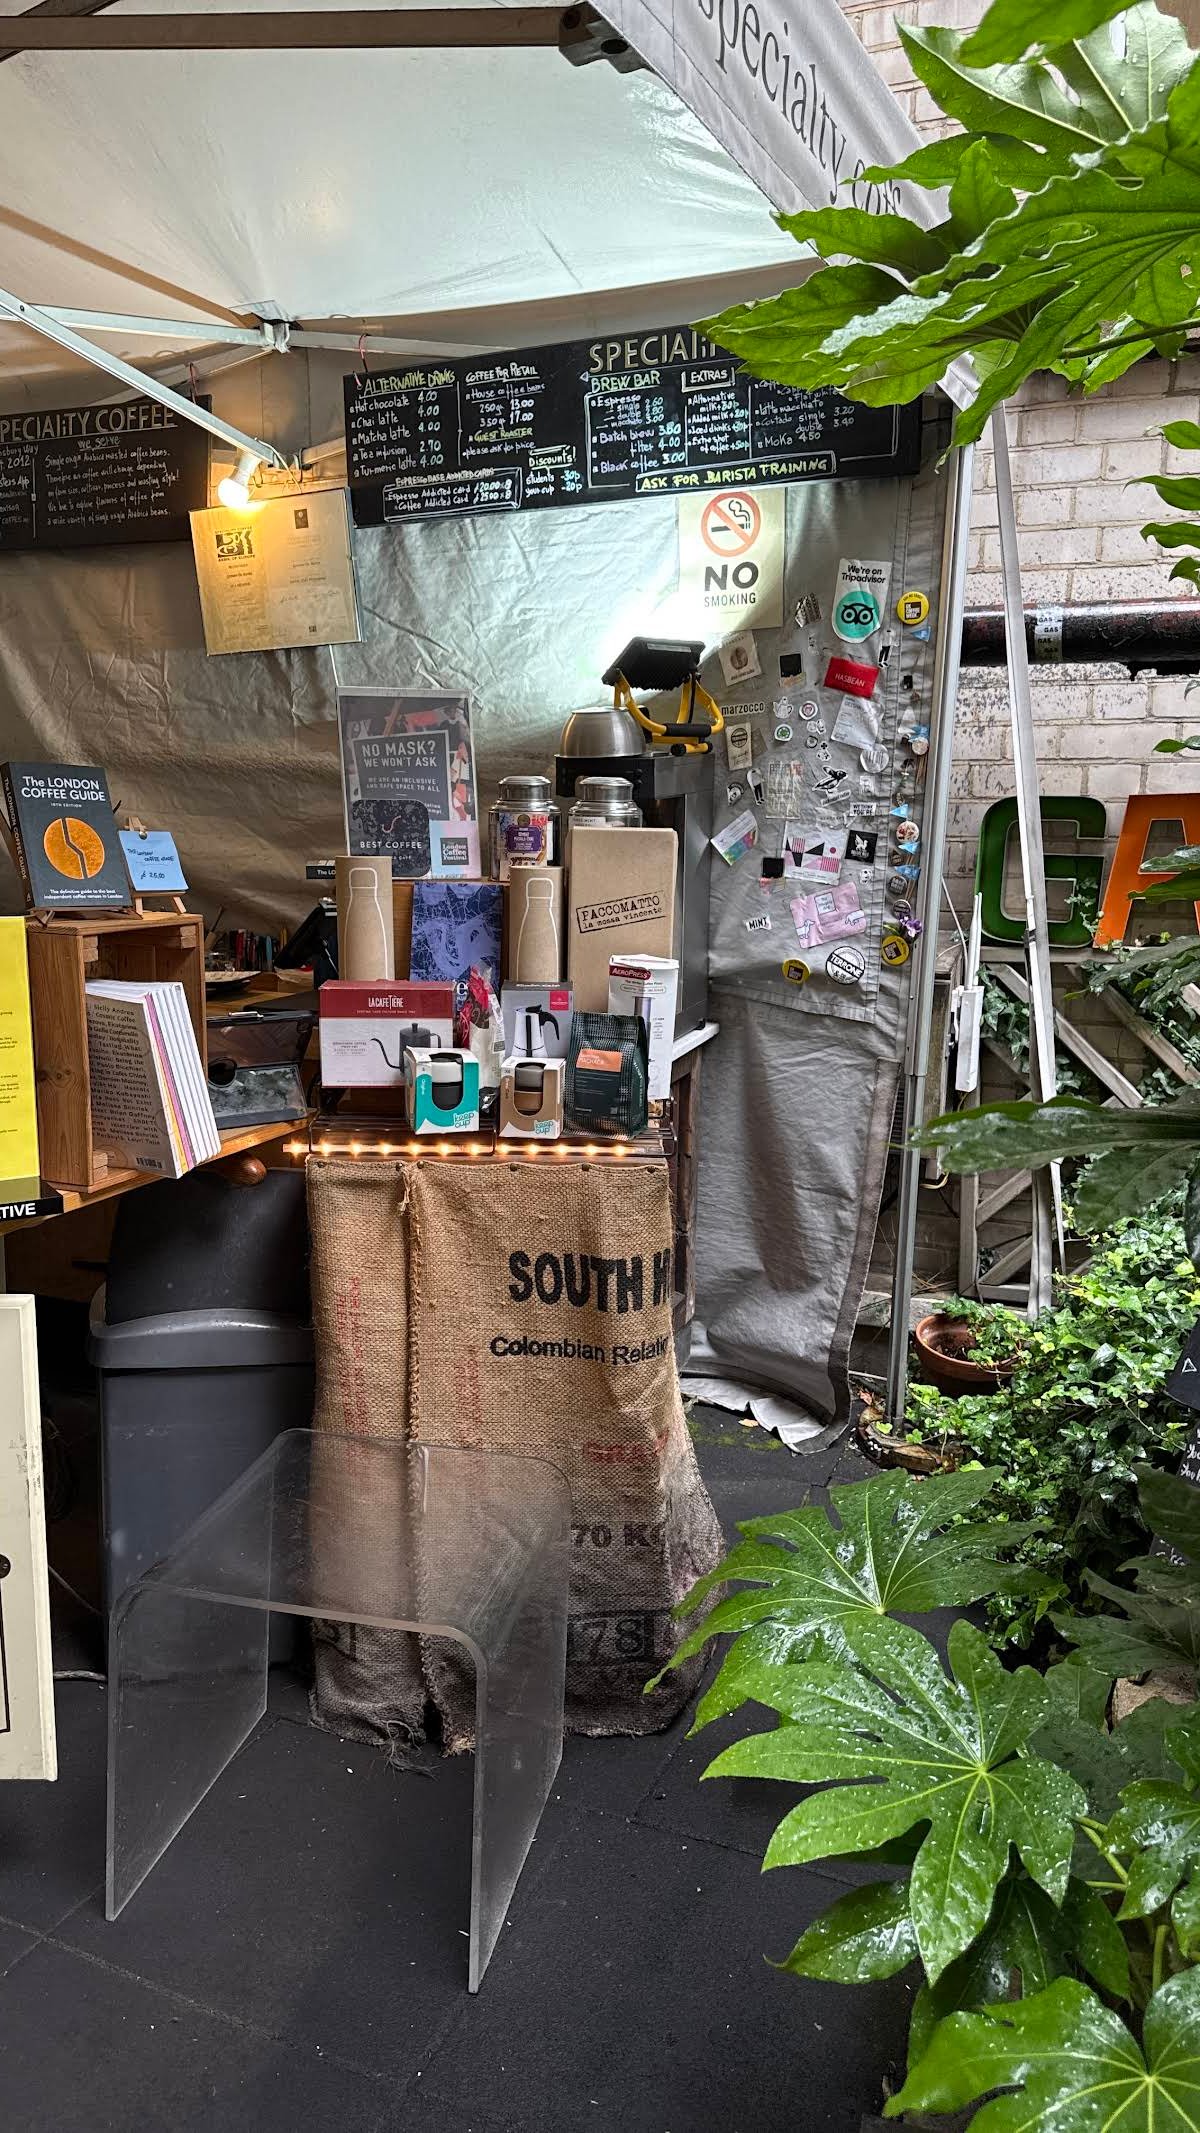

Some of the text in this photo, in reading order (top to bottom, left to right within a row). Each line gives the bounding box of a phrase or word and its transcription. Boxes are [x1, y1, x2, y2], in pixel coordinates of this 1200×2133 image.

[698, 0, 846, 204] pecialty
[465, 370, 495, 382] COFFEE
[510, 362, 538, 378] RETAIL
[690, 369, 728, 383] EXTRAS
[363, 368, 455, 397] ALTERNATIVE DRINKS
[591, 370, 660, 393] BREW BAR
[471, 388, 496, 400] House
[497, 383, 525, 400] coffee
[693, 391, 735, 406] Alternative
[355, 391, 438, 413] Hot chocolate 4.00
[510, 398, 535, 410] 13.00
[597, 394, 641, 409] Espresso
[779, 399, 824, 413] macchiato
[95, 404, 175, 432] COFFEE
[357, 405, 440, 428] Chai latte 4.00
[509, 410, 534, 425] 17.00
[799, 405, 855, 423] single 3.20
[358, 421, 440, 444] Matcha latte 4.00
[709, 422, 732, 433] drinks
[795, 419, 824, 434] double
[474, 427, 533, 443] GUEST ROASTER
[600, 430, 627, 444] Batch
[630, 429, 655, 440] brew
[712, 432, 730, 443] shot
[23, 435, 121, 455] Way serve
[359, 439, 441, 460] Tea infusion 2.70
[466, 445, 489, 460] please
[515, 441, 536, 454] price
[8, 454, 31, 469] 2012
[529, 446, 577, 467] Discounts!
[631, 454, 660, 473] coffee
[662, 452, 686, 465] 3.00
[360, 454, 444, 476] Turmeric latte 4.00
[526, 471, 554, 485] students
[641, 458, 827, 491] ASK FOR BARISTA TRAINING
[704, 561, 759, 591] NO
[841, 572, 886, 584] Tripadvisor
[847, 564, 882, 576] We're on
[704, 592, 756, 608] SMOKING
[834, 672, 865, 687] HASBEAN
[721, 702, 764, 716] marzocco
[362, 740, 436, 757] NO MASK?
[364, 757, 437, 768] WE WON'T ASK
[22, 776, 100, 790] The LONDON
[401, 777, 436, 785] INCLUSIVE
[21, 788, 106, 802] COFFEE GUIDE
[360, 841, 422, 849] BEST COFFEE
[583, 907, 663, 930] la mossa vincente
[748, 917, 768, 930] MINT
[829, 953, 863, 978] TERRONE
[454, 1112, 475, 1123] keep
[454, 1119, 471, 1129] cup
[534, 1120, 554, 1130] keep
[535, 1126, 550, 1135] cup
[0, 1202, 37, 1219] TIVE
[509, 1250, 643, 1314] SOUTH
[489, 1335, 606, 1363] Colombian
[571, 1522, 612, 1547] 70
